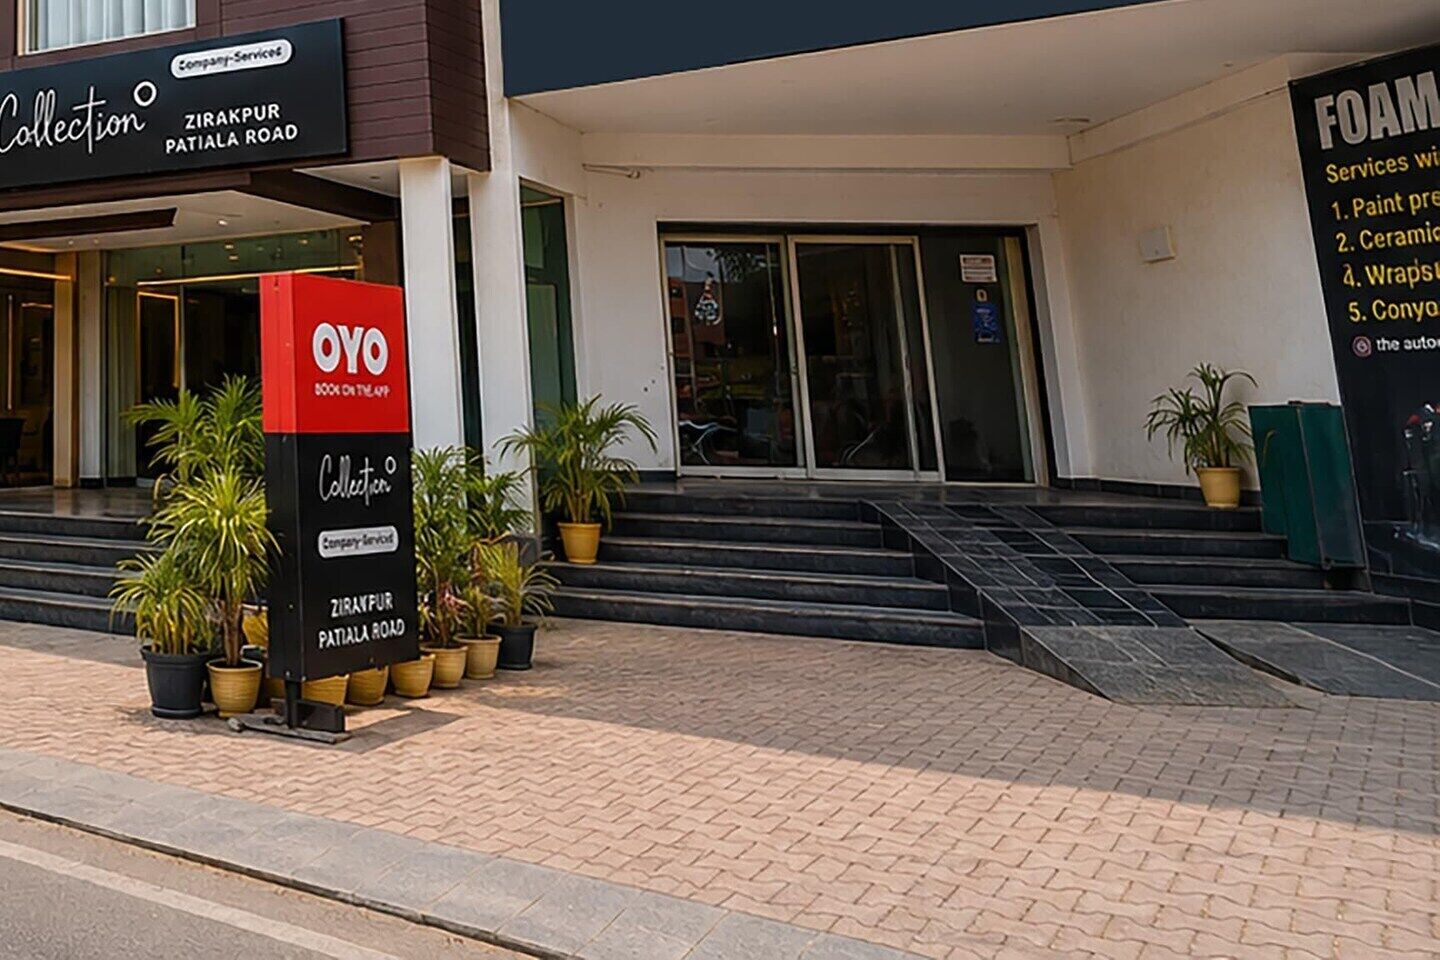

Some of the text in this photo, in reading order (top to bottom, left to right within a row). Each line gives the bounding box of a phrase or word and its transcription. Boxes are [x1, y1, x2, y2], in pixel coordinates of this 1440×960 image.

[185, 103, 280, 130] ZIRAKPUR
[165, 123, 298, 154] PATIALA ROAD
[1326, 156, 1409, 183] Services
[1331, 201, 1349, 221] 1.
[1352, 192, 1405, 218] Paint
[1336, 232, 1355, 253] 2.
[1348, 301, 1367, 322] 5.
[312, 322, 389, 376] OYO
[1376, 337, 1400, 351] the
